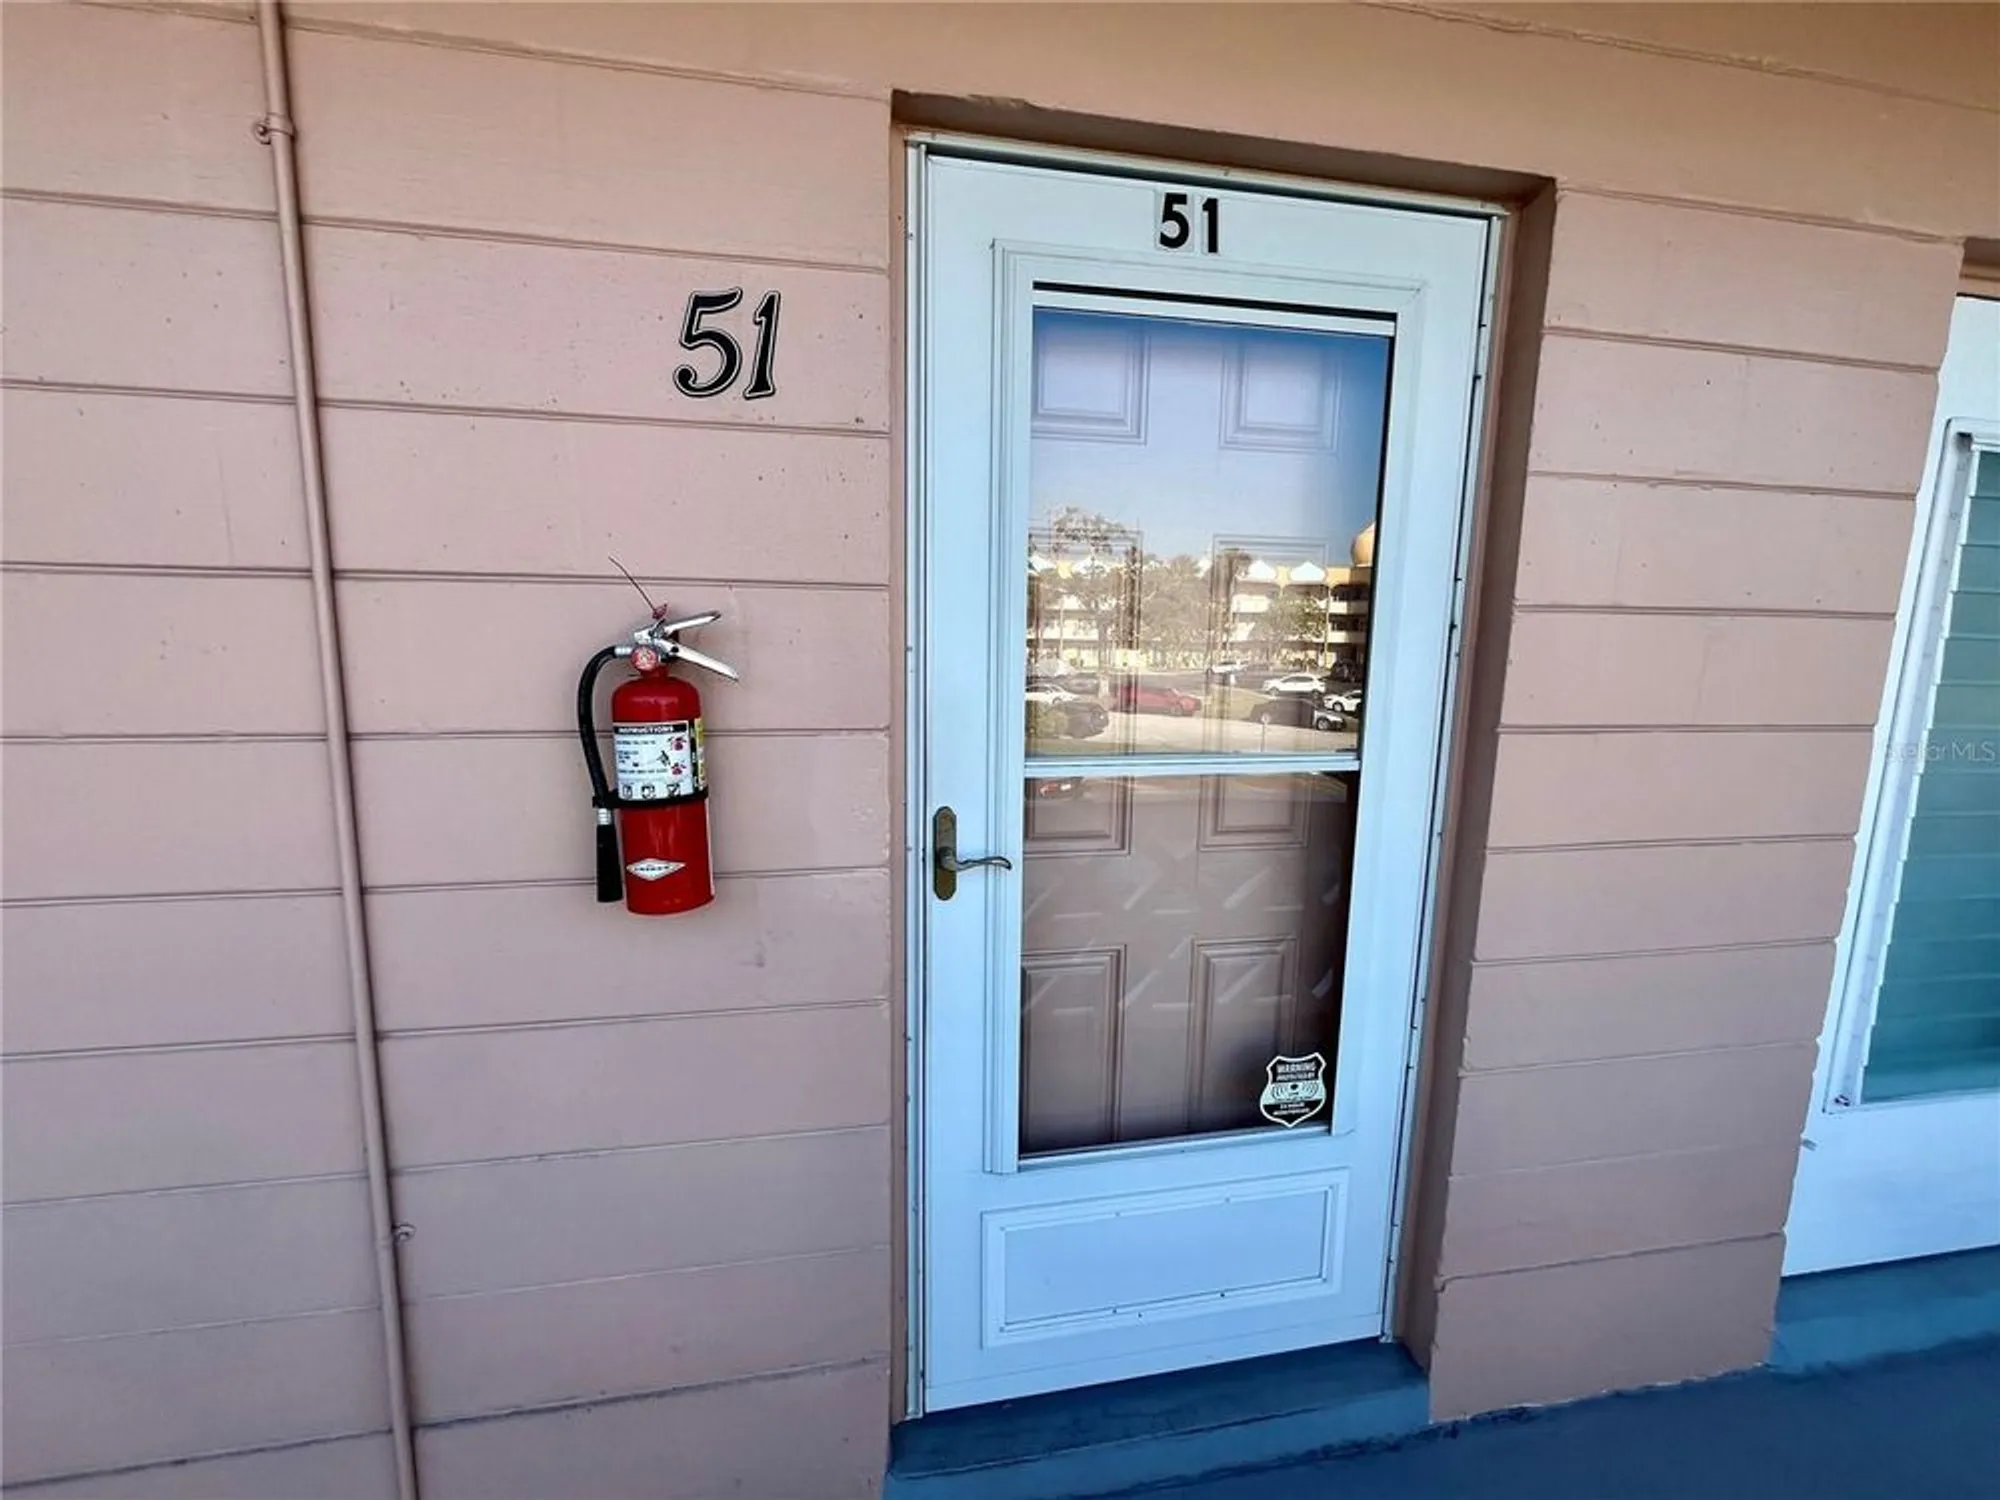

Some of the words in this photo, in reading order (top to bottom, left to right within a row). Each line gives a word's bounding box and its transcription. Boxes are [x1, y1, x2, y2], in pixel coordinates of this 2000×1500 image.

[1159, 192, 1218, 253] 51
[673, 286, 781, 400] 51
[1276, 1062, 1316, 1073] WARNING
